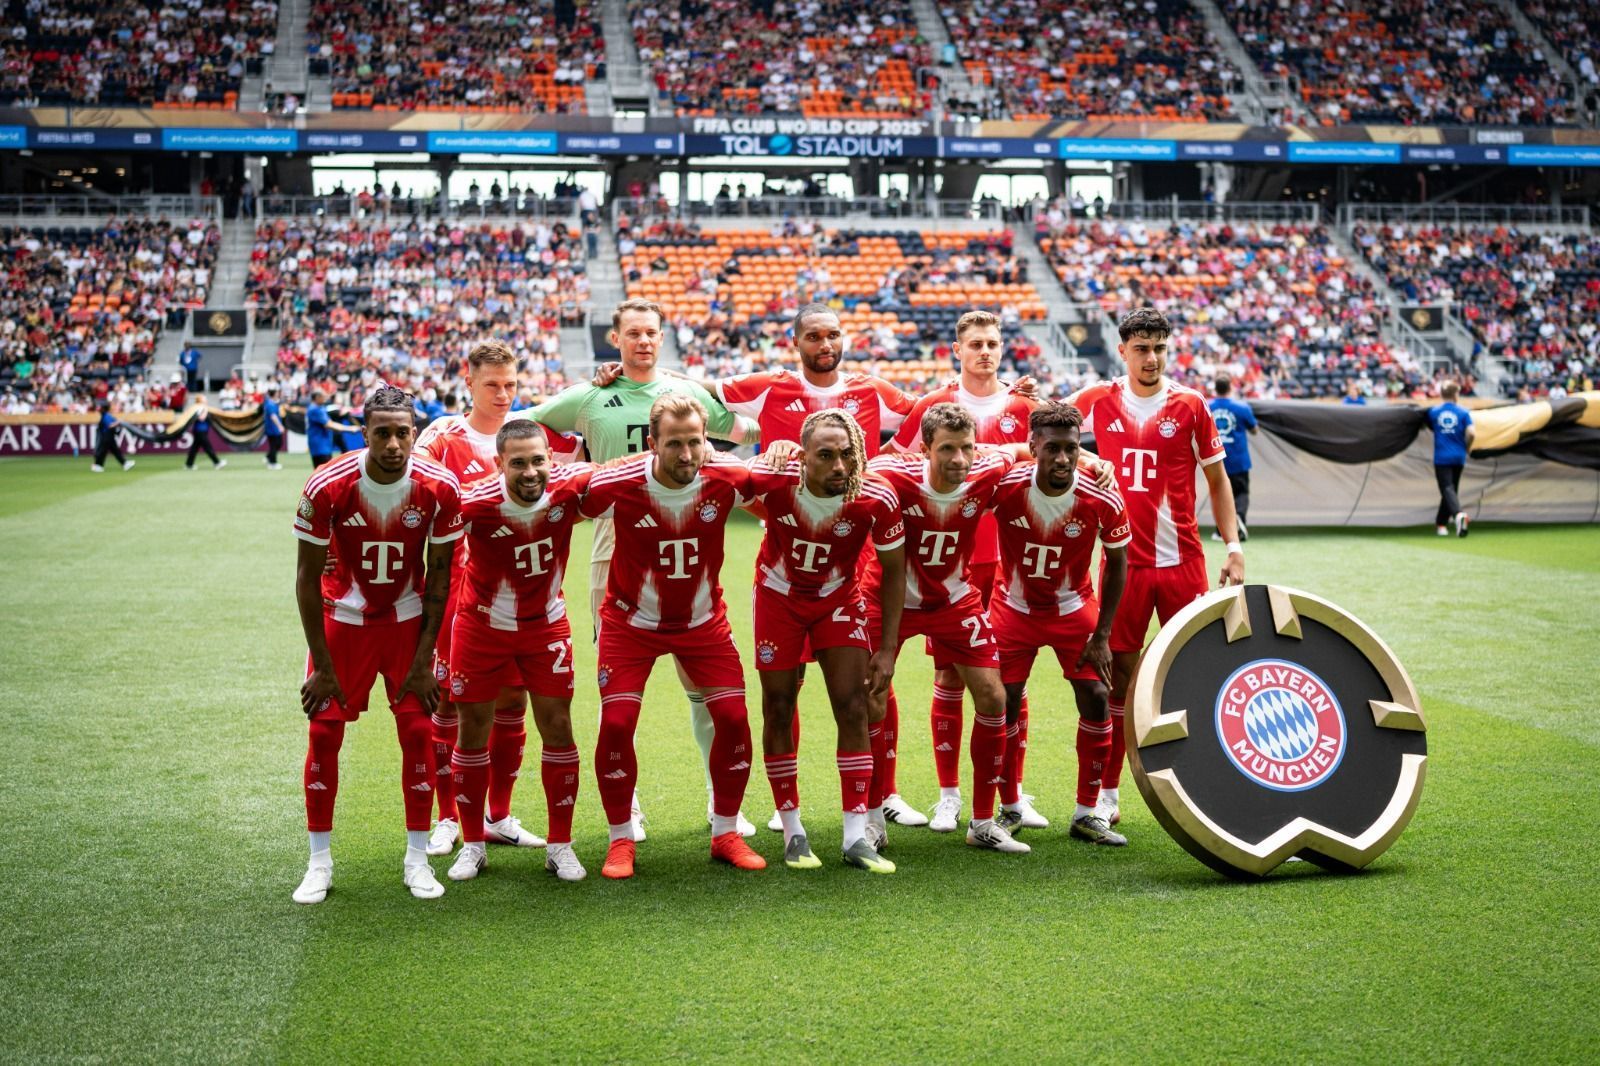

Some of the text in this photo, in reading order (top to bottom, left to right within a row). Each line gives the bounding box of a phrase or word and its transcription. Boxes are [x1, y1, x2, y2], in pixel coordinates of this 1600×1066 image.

[694, 119, 731, 134] FIFA
[732, 119, 776, 134] CLUB
[777, 119, 843, 134] WORLD
[844, 120, 879, 135] CUP
[721, 136, 904, 156] TQL STADIUM
[1121, 448, 1157, 492] T
[361, 541, 405, 584] T
[514, 537, 554, 578] T
[658, 537, 699, 579] T
[791, 538, 832, 573] T
[918, 531, 960, 566] T
[1022, 542, 1063, 579] T
[1225, 668, 1331, 717] FC BAYERN
[1233, 734, 1337, 782] MÜNCHEN
